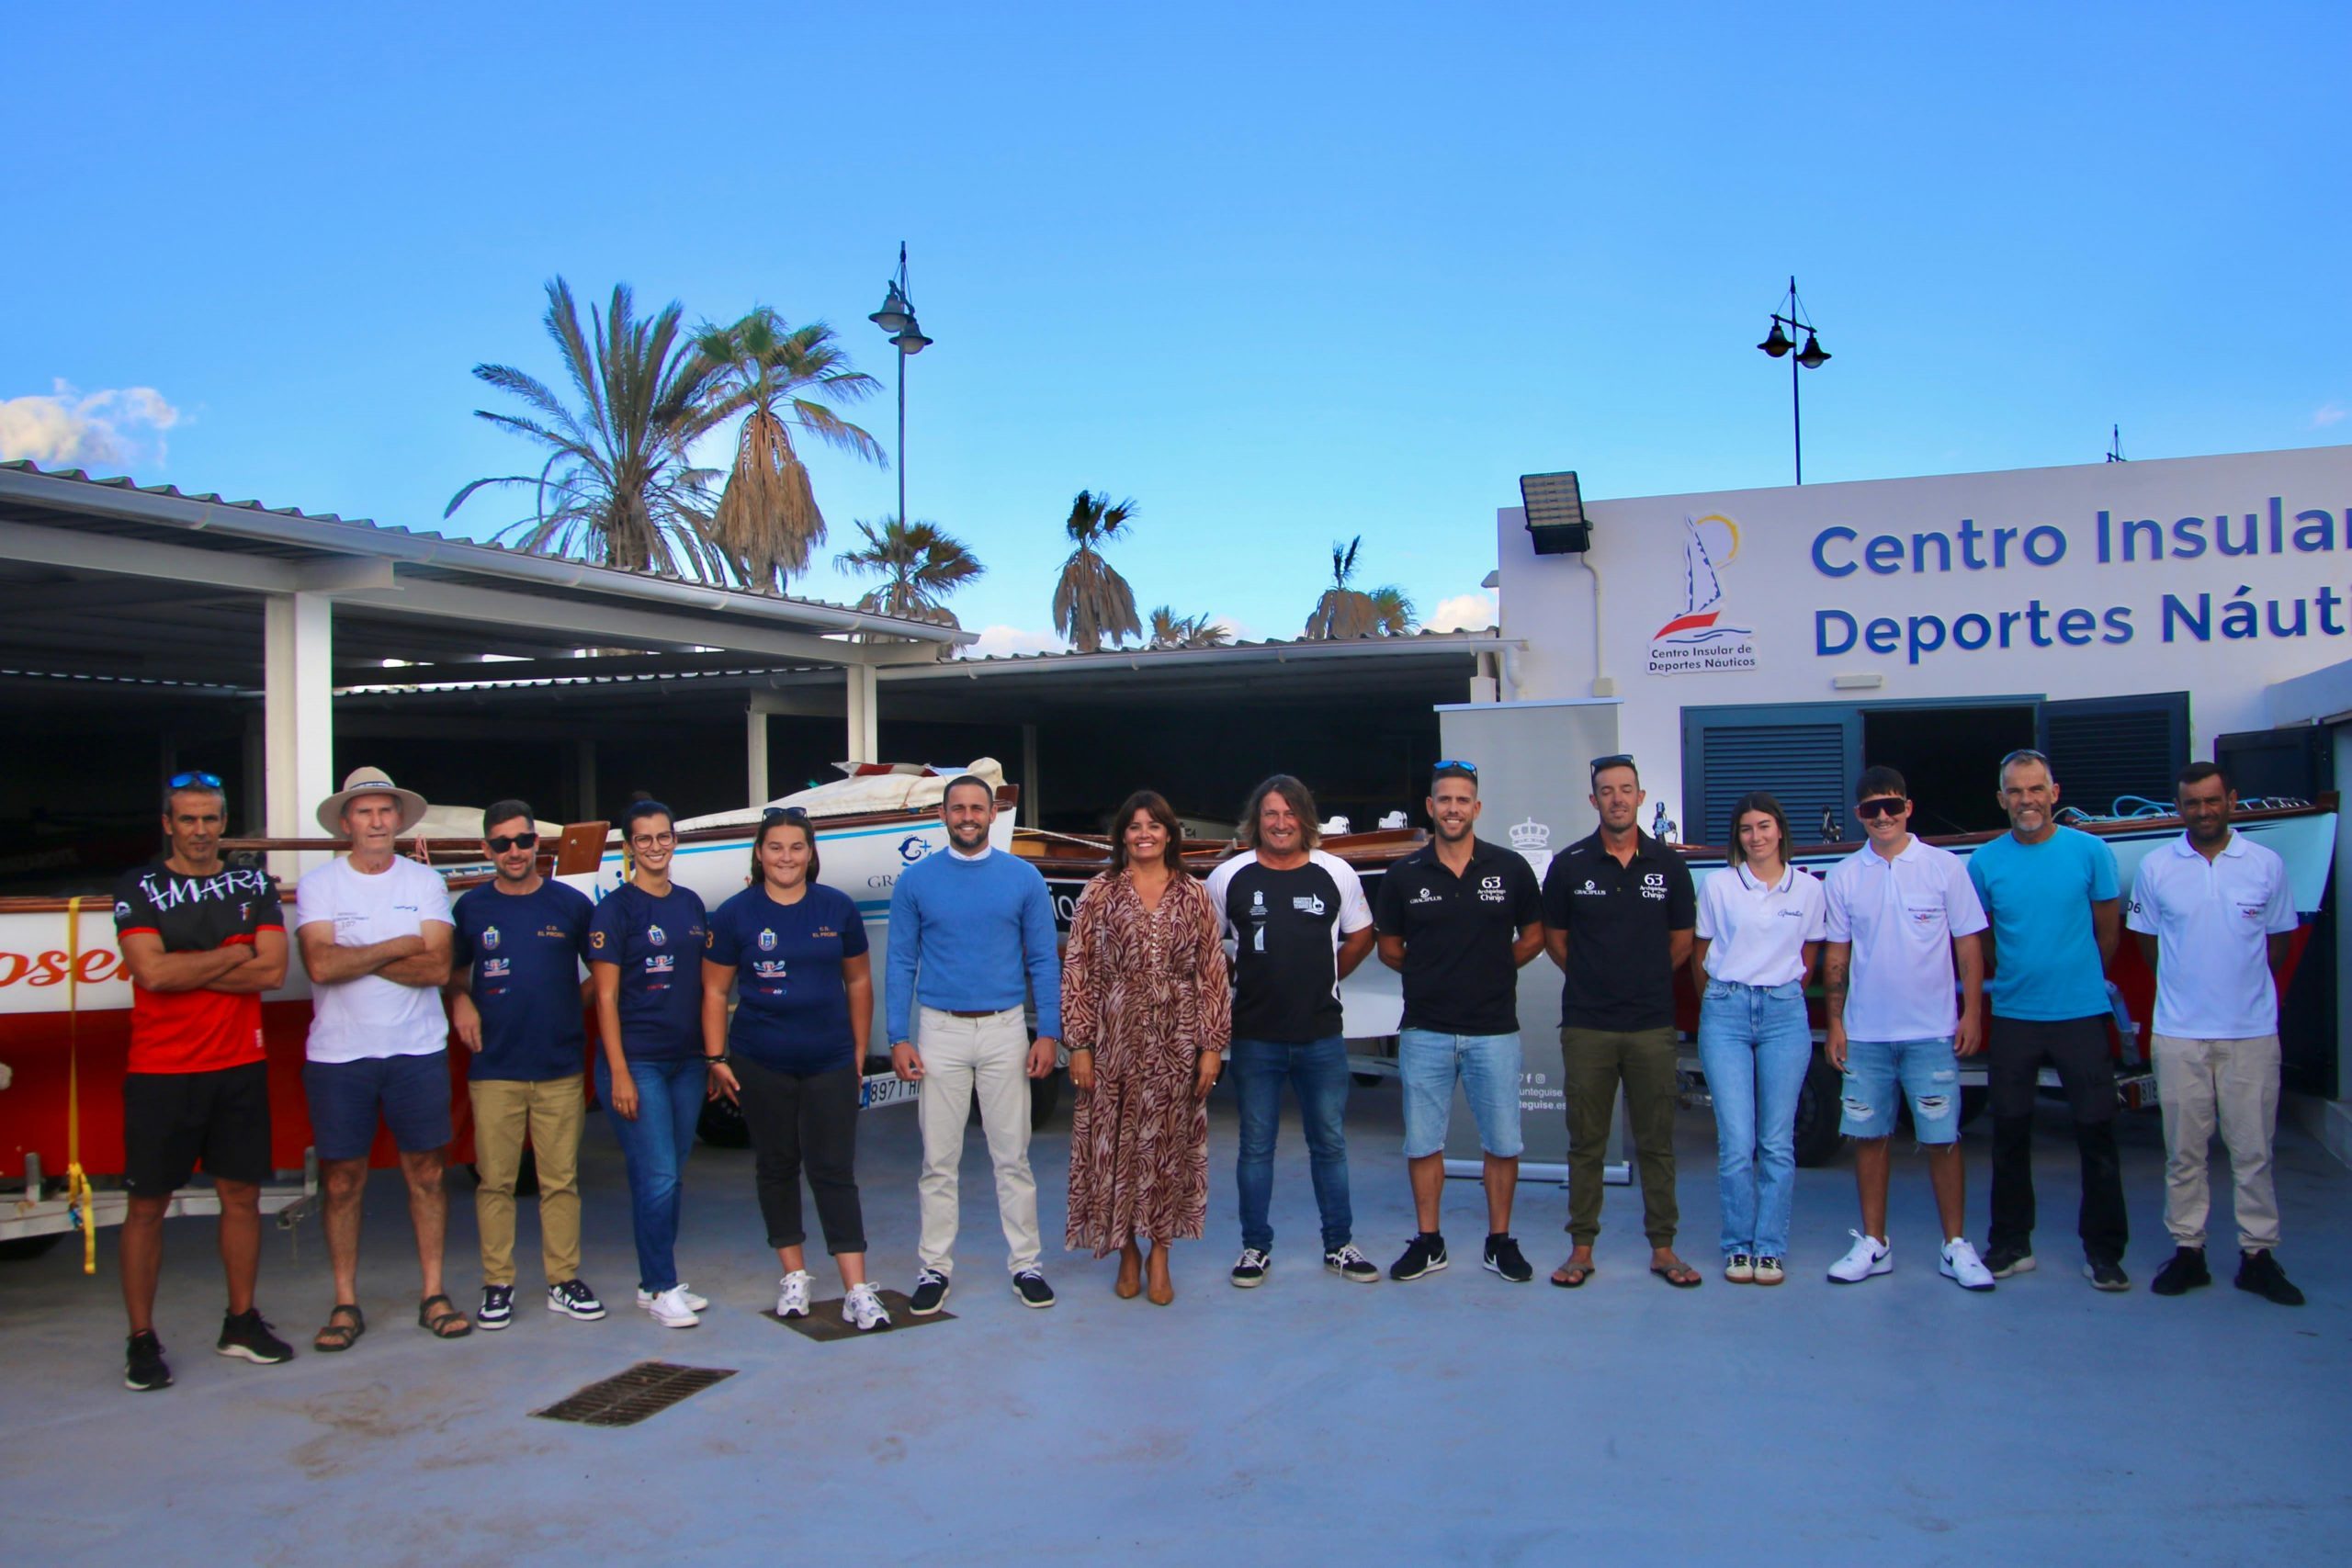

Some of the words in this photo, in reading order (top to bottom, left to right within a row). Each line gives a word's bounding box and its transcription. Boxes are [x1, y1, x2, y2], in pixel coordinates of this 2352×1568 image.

[1811, 518, 2067, 578] Centro
[1815, 599, 2134, 665] Deportes
[2162, 584, 2352, 643] Náut
[1651, 649, 1690, 659] Centro
[1693, 645, 1734, 657] Insular
[1737, 644, 1752, 654] de
[1649, 660, 1702, 672] Deportes
[1705, 658, 1756, 669] Náuticos
[867, 874, 900, 889] GR
[1481, 875, 1501, 889] 63
[1644, 873, 1664, 886] 63
[870, 1079, 903, 1102] 8971
